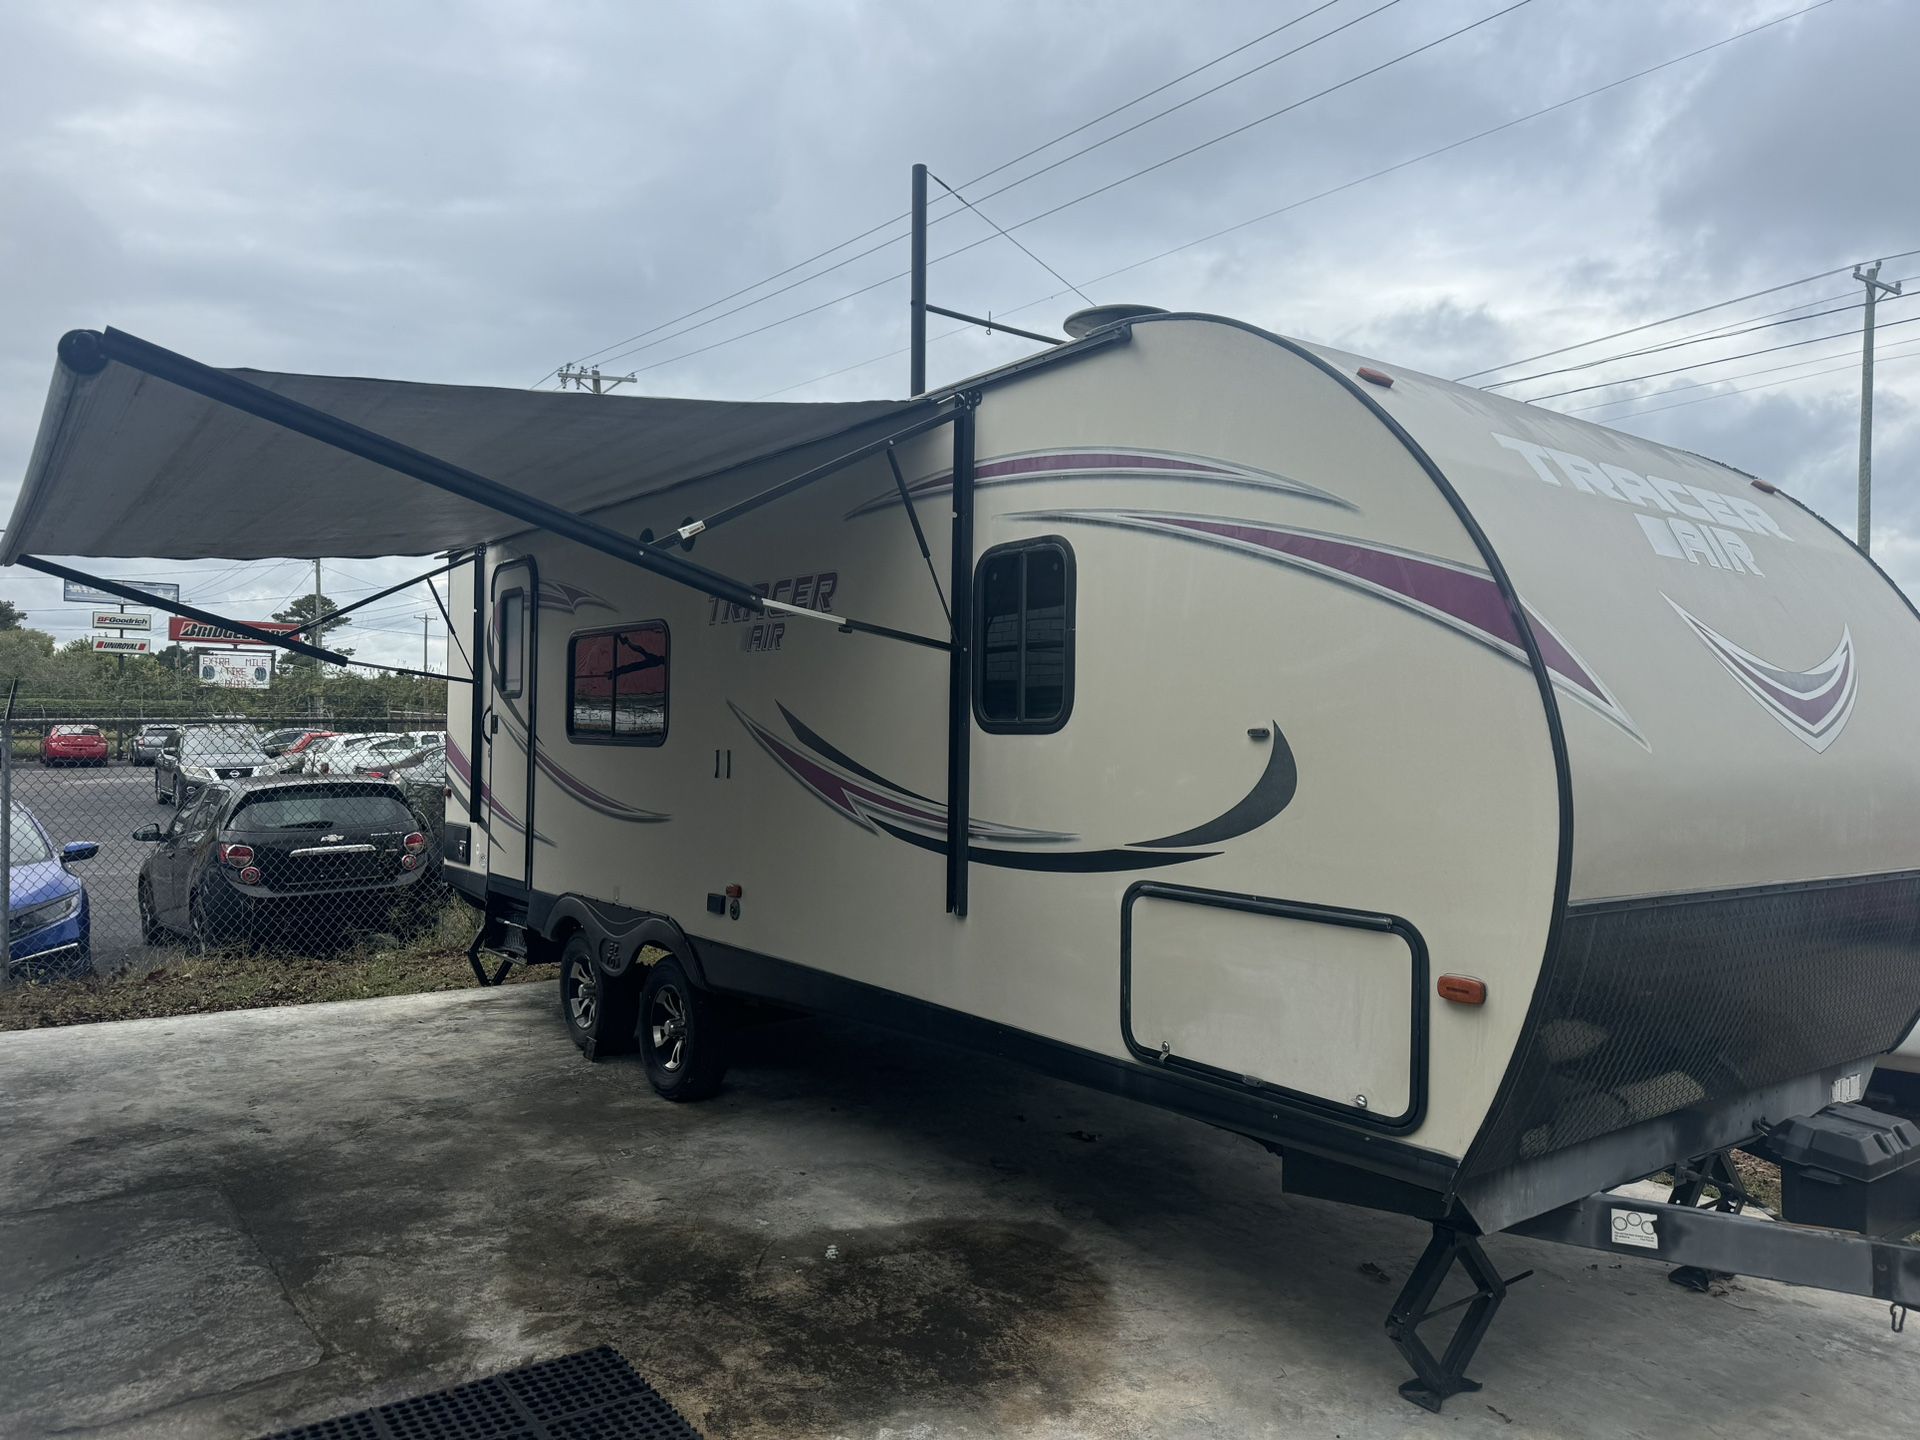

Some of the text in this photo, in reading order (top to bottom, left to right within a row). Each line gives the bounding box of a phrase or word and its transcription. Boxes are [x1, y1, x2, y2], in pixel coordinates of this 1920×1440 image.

[1491, 432, 1794, 543] TRACER
[1664, 515, 1766, 579] AIR
[96, 616, 148, 625] BFGoodrich
[103, 641, 138, 650] UNIROYAL
[747, 622, 786, 653] AIR
[202, 657, 267, 667] EXTRA MILE
